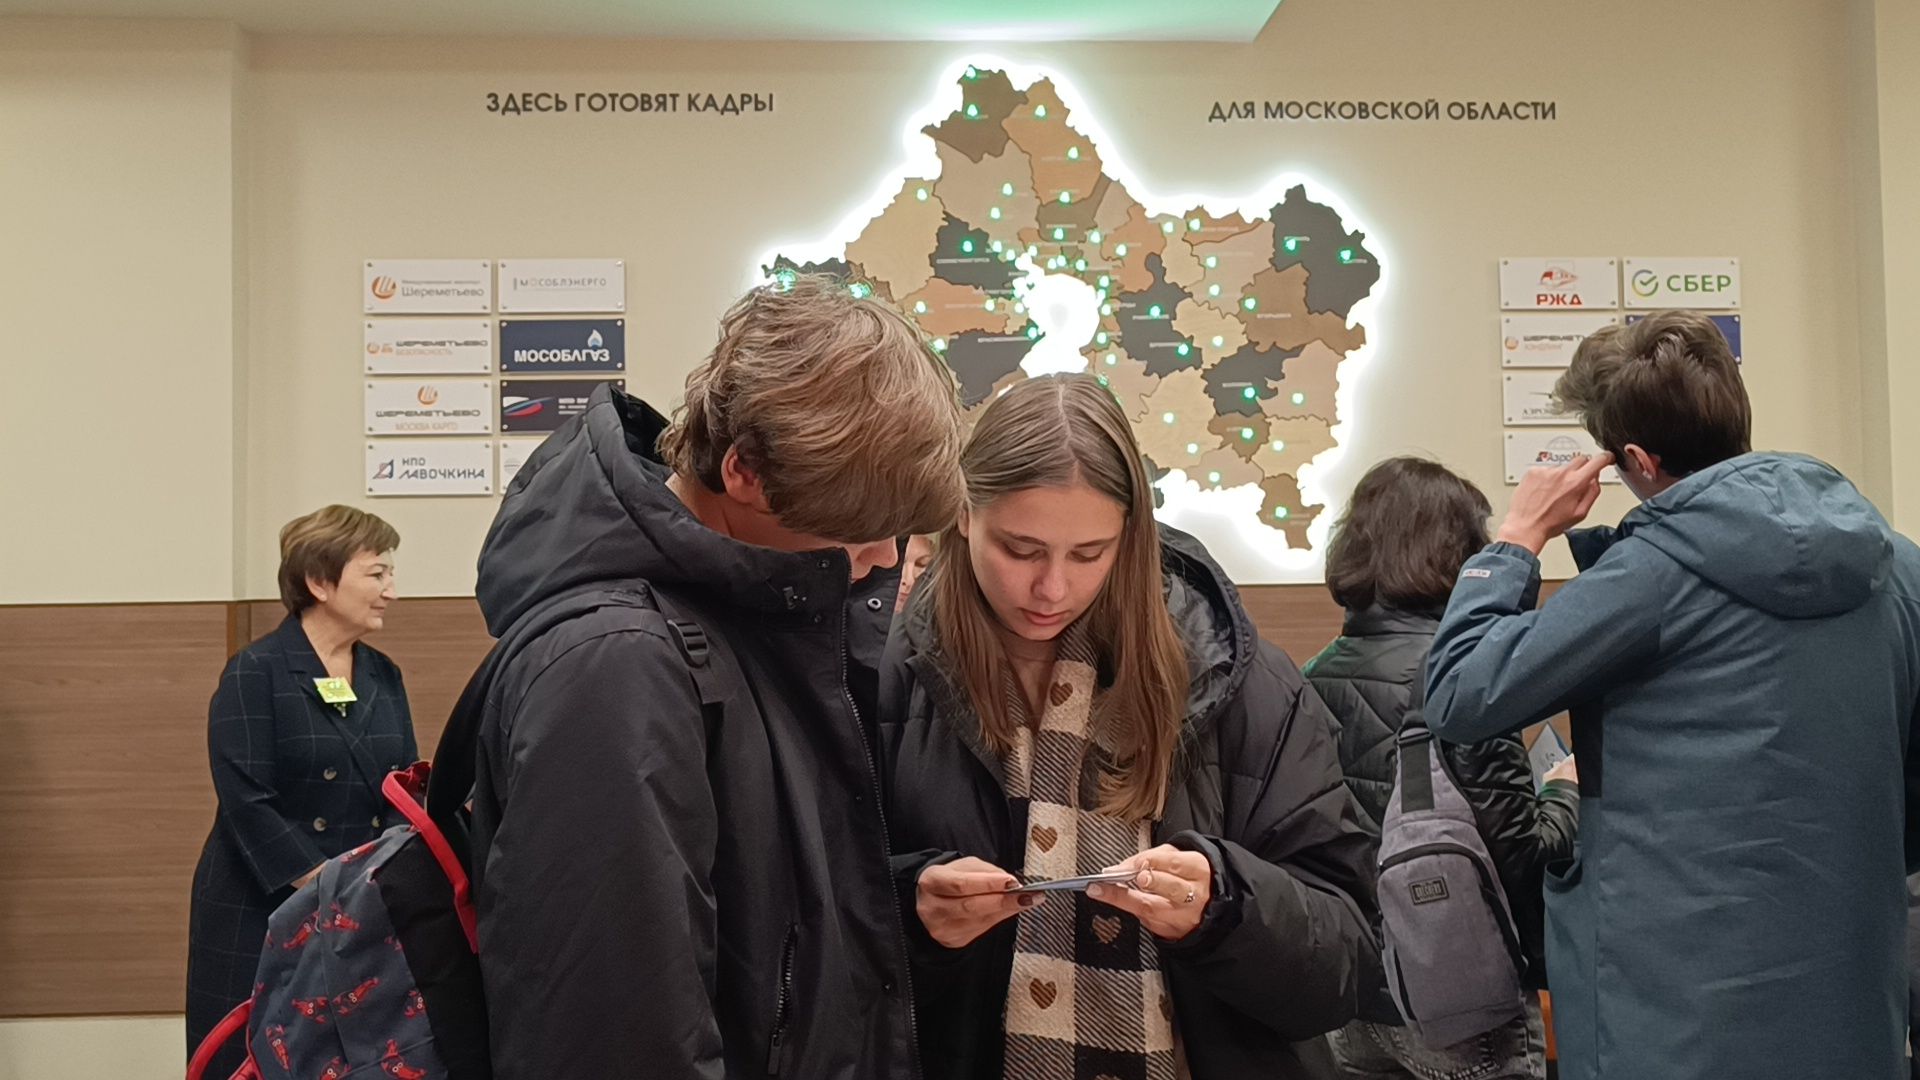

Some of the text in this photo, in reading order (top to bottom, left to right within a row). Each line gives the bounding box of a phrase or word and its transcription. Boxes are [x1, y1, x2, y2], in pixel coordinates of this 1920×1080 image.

[486, 92, 775, 116] ЗДЕСЬ ГОТОВЯТ КАДРЫ
[1208, 98, 1556, 123] ДЛЯ МОСКОВСКОЙ ОБЛАСТИ
[520, 277, 607, 287] МОСОБЛЭНЕРГО
[1666, 274, 1732, 293] СБЕР
[401, 286, 485, 298] Шереметьево
[1536, 293, 1583, 306] РЖД
[514, 348, 610, 363] МОСОБЛГАЗ
[375, 409, 481, 418] ШЕРЕМЕТЬЕВО
[402, 457, 426, 467] НПО
[399, 468, 485, 480] ЛАВОЧКИНА
